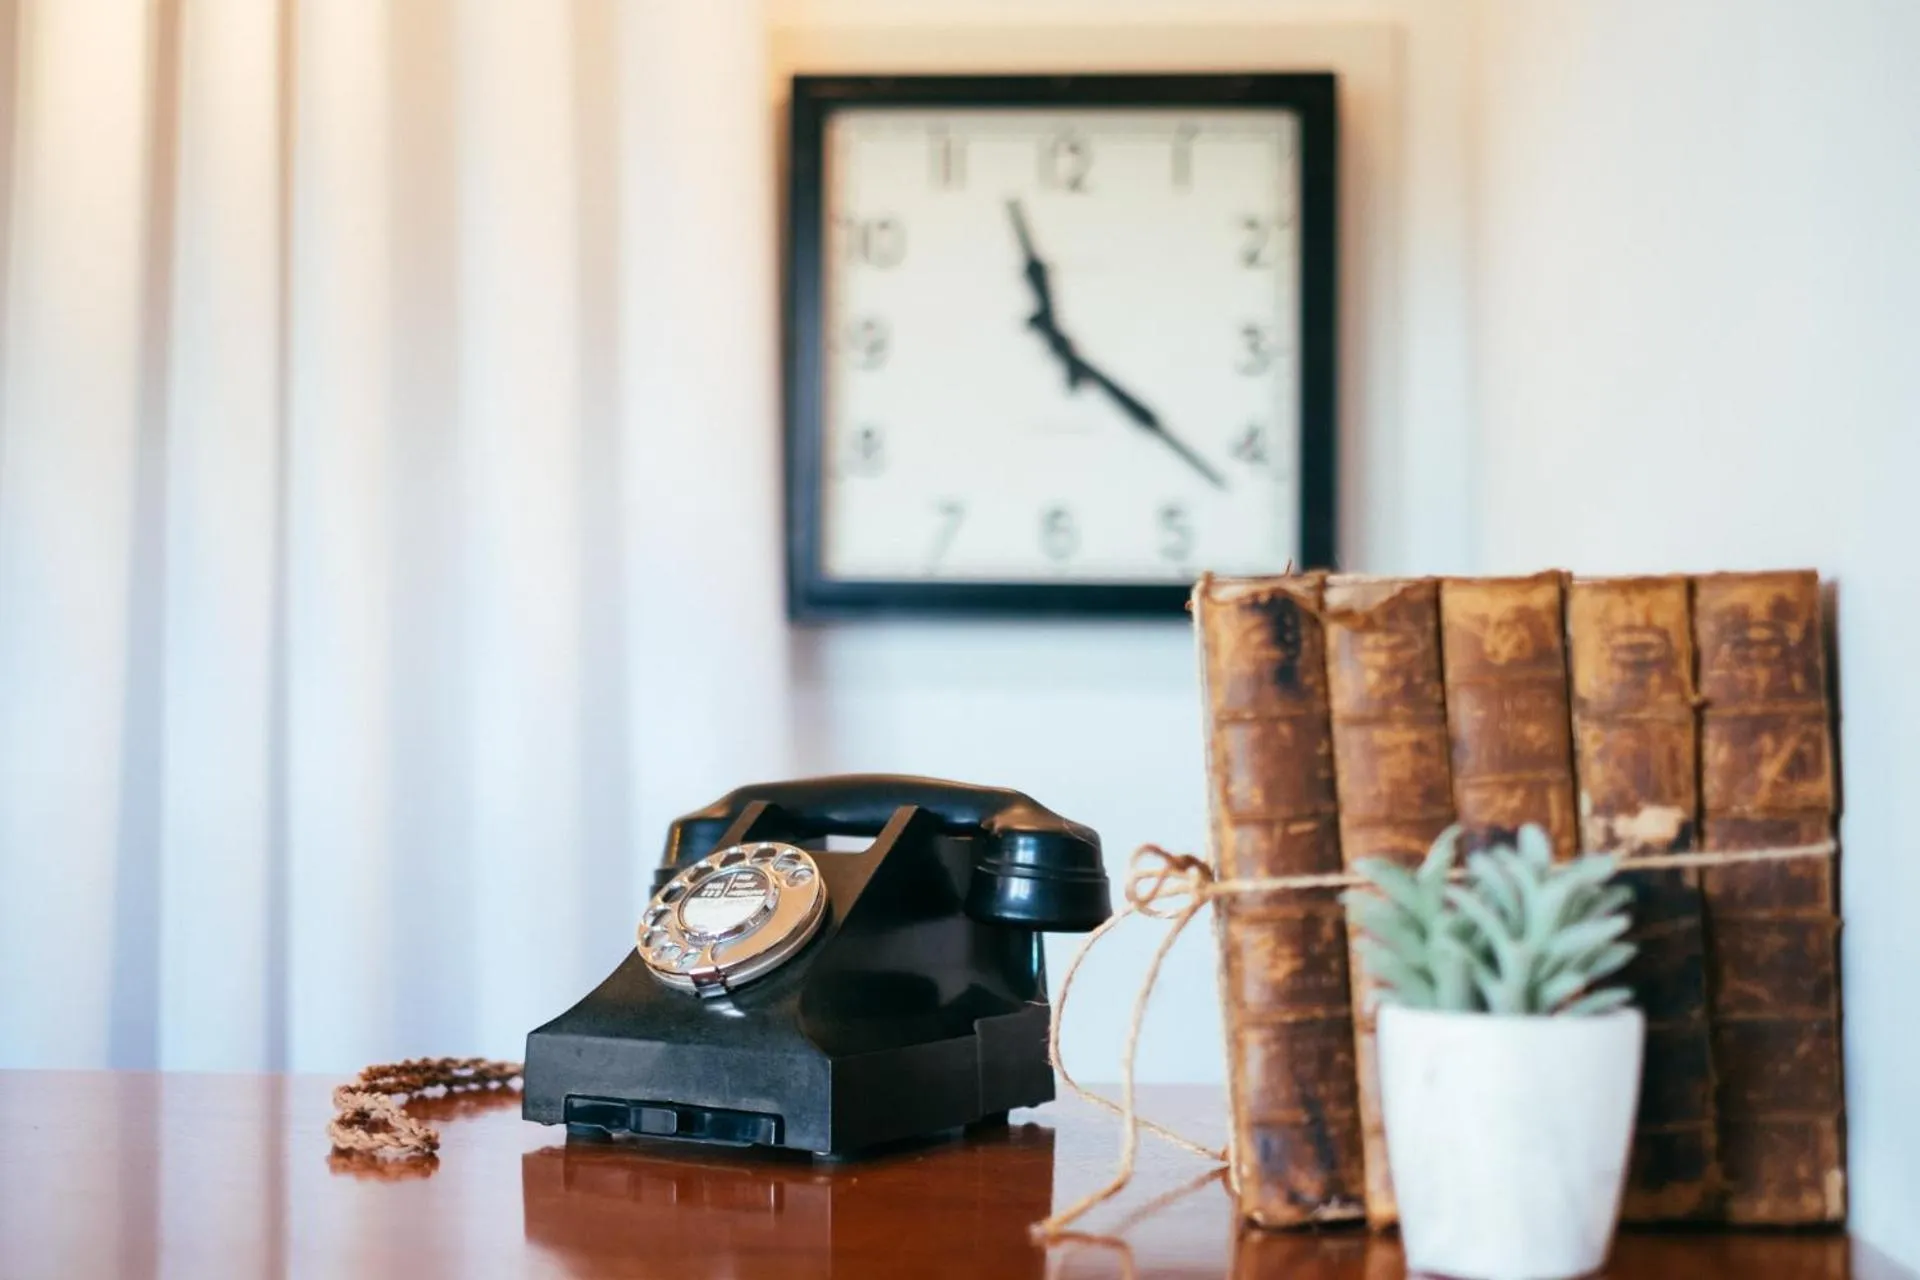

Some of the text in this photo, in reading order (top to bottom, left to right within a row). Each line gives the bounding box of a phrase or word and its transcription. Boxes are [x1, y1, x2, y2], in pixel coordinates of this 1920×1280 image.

[1038, 129, 1094, 193] 12
[848, 212, 907, 270] 10
[1232, 211, 1271, 270] 2
[849, 313, 894, 371] 9
[1233, 317, 1271, 376] 3
[848, 421, 888, 478] 8
[1228, 421, 1270, 466] 4
[927, 497, 967, 563] 7
[1038, 499, 1083, 562] 6
[1154, 498, 1197, 562] 5
